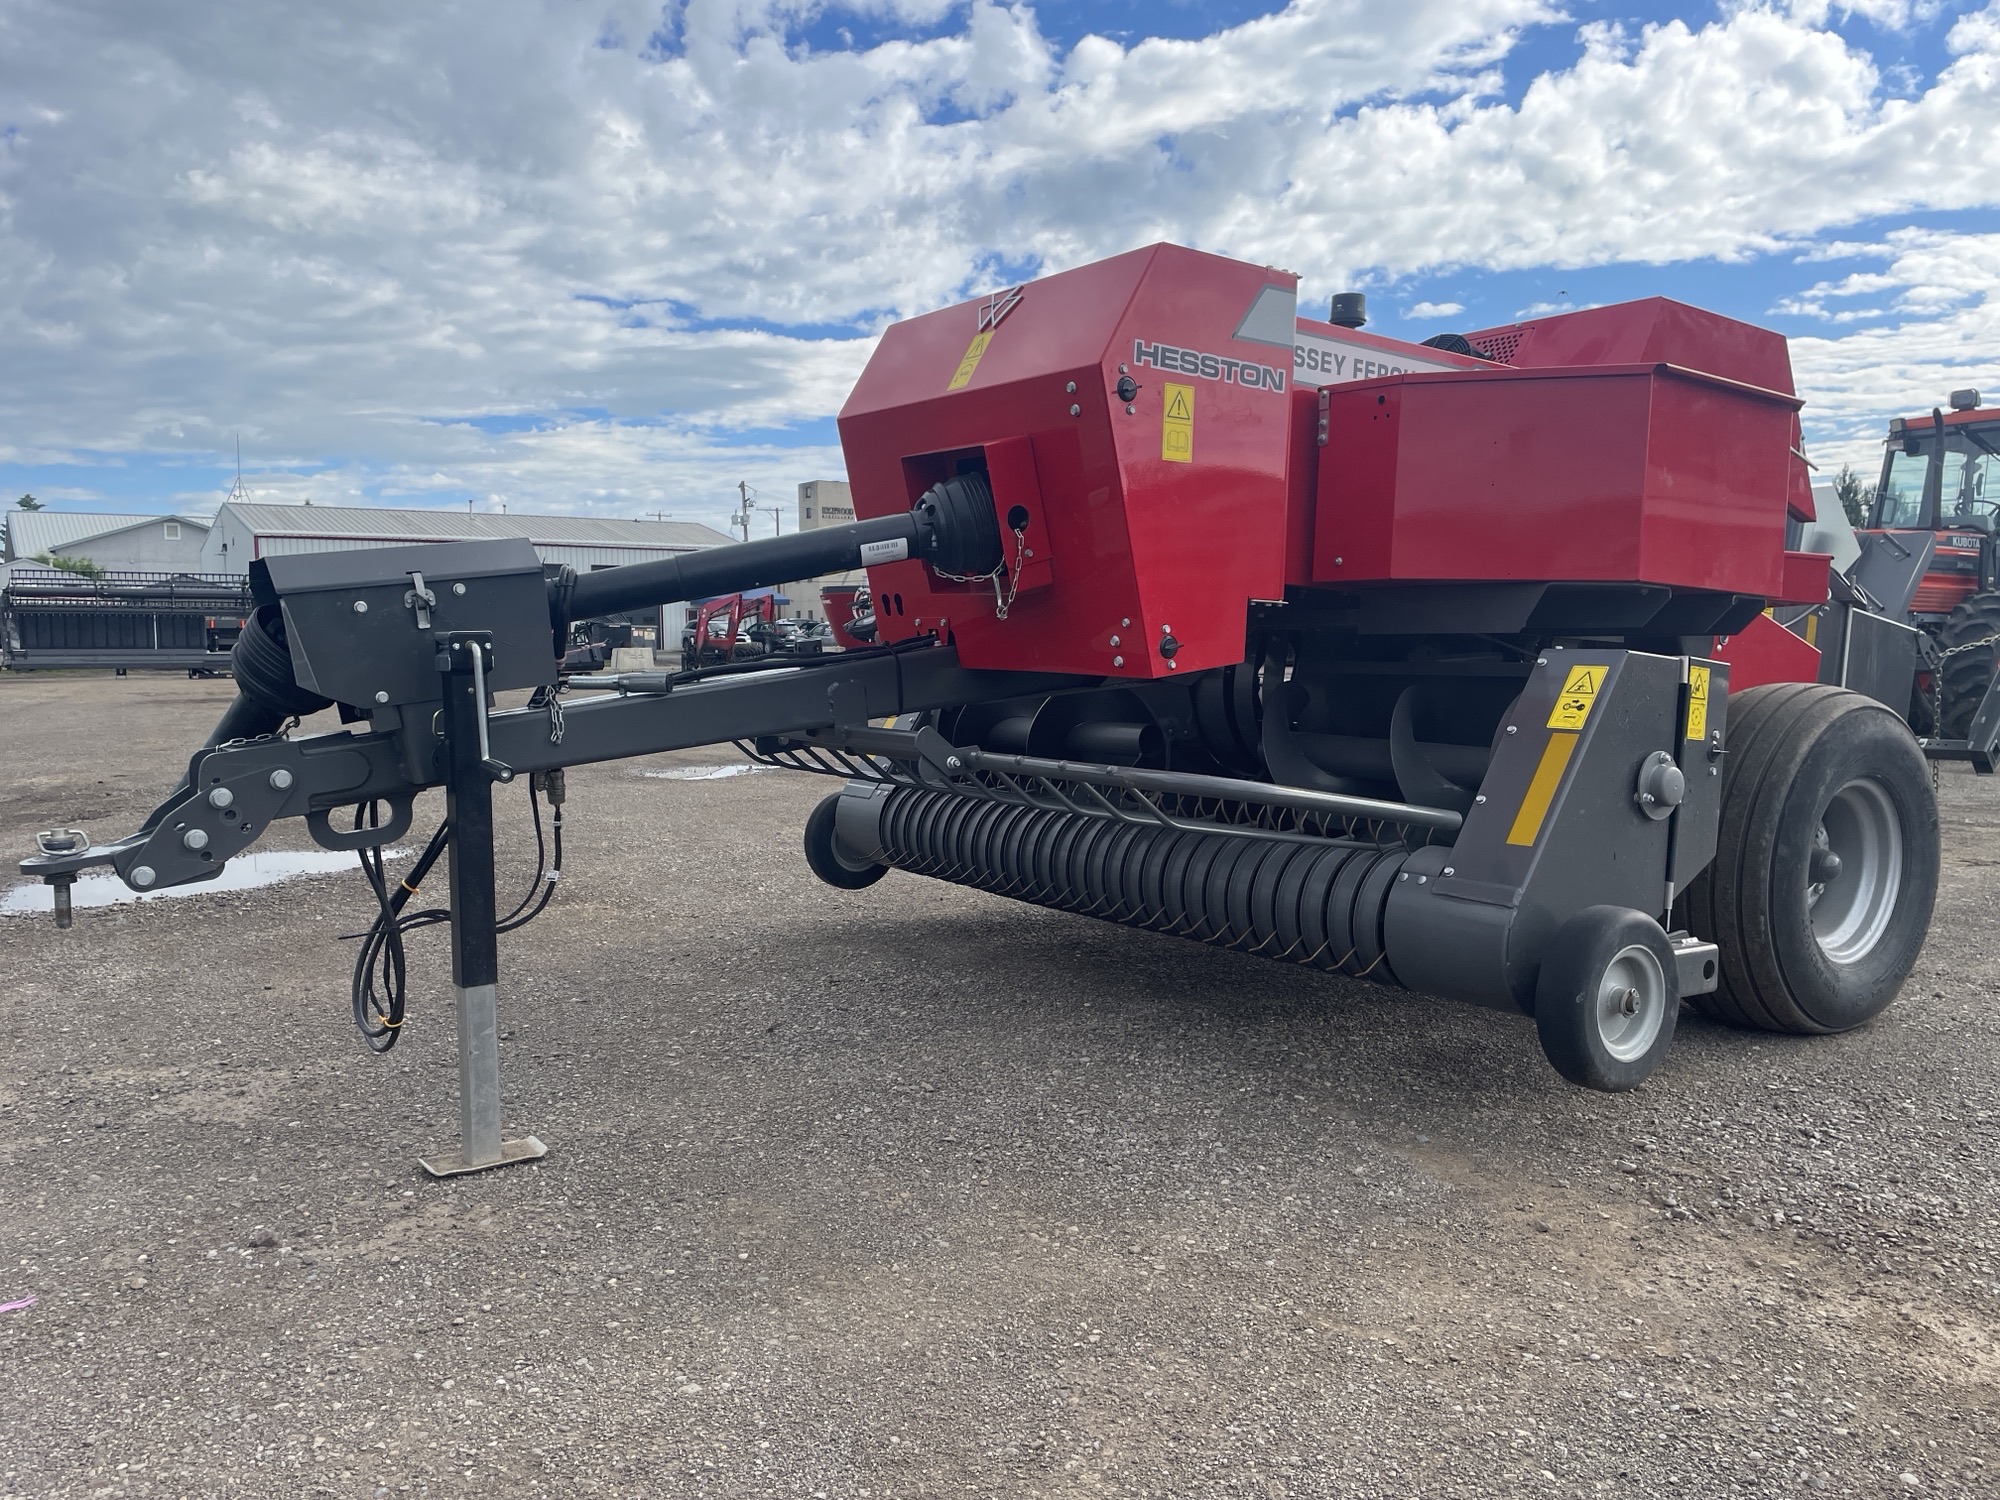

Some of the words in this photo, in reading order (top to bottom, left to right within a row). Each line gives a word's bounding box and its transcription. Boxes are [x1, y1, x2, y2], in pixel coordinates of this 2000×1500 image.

[1135, 340, 1285, 393] HESSTON
[1294, 345, 1346, 376] SSEY
[1353, 358, 1416, 379] FER
[1952, 536, 1980, 548] KUBOTA
